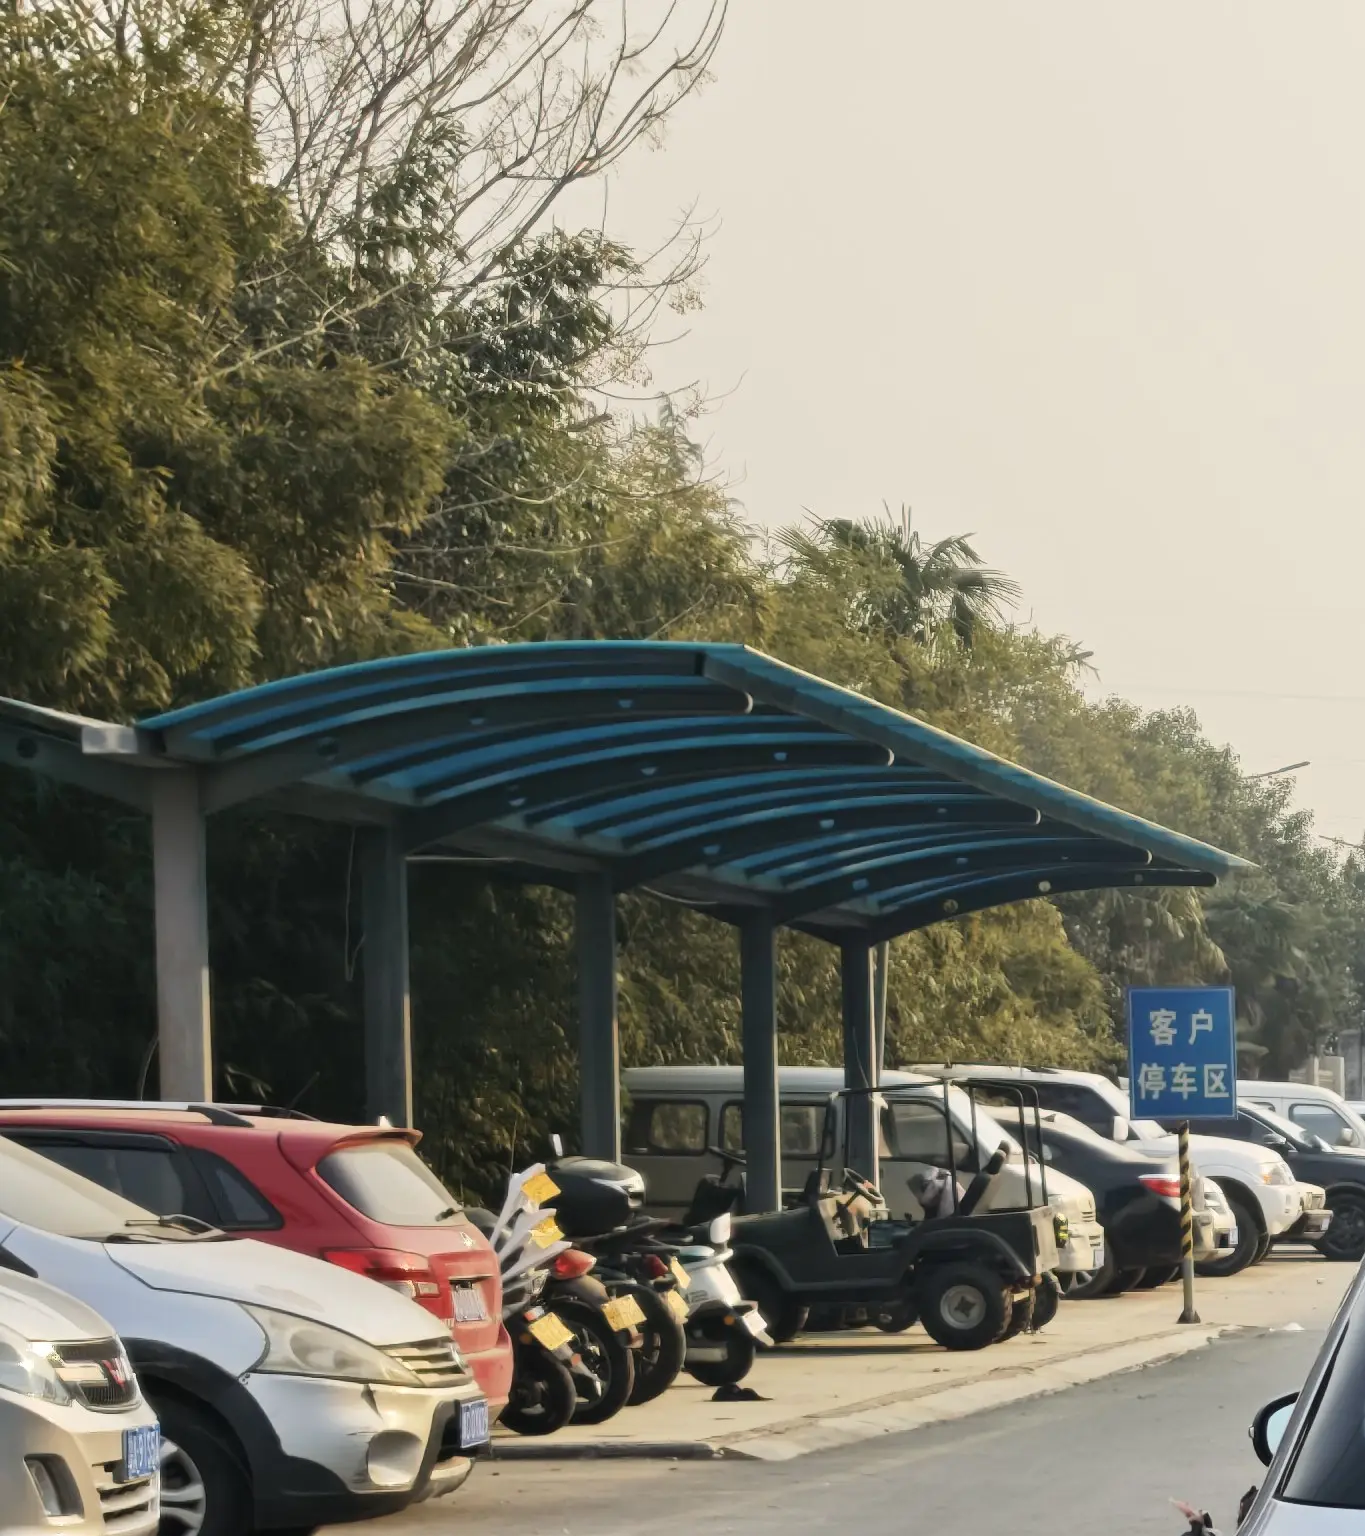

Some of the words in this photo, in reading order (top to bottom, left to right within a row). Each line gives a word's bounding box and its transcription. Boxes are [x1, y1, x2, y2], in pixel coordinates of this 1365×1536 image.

[1149, 1008, 1214, 1046] 客户
[1137, 1063, 1230, 1100] 停车区
